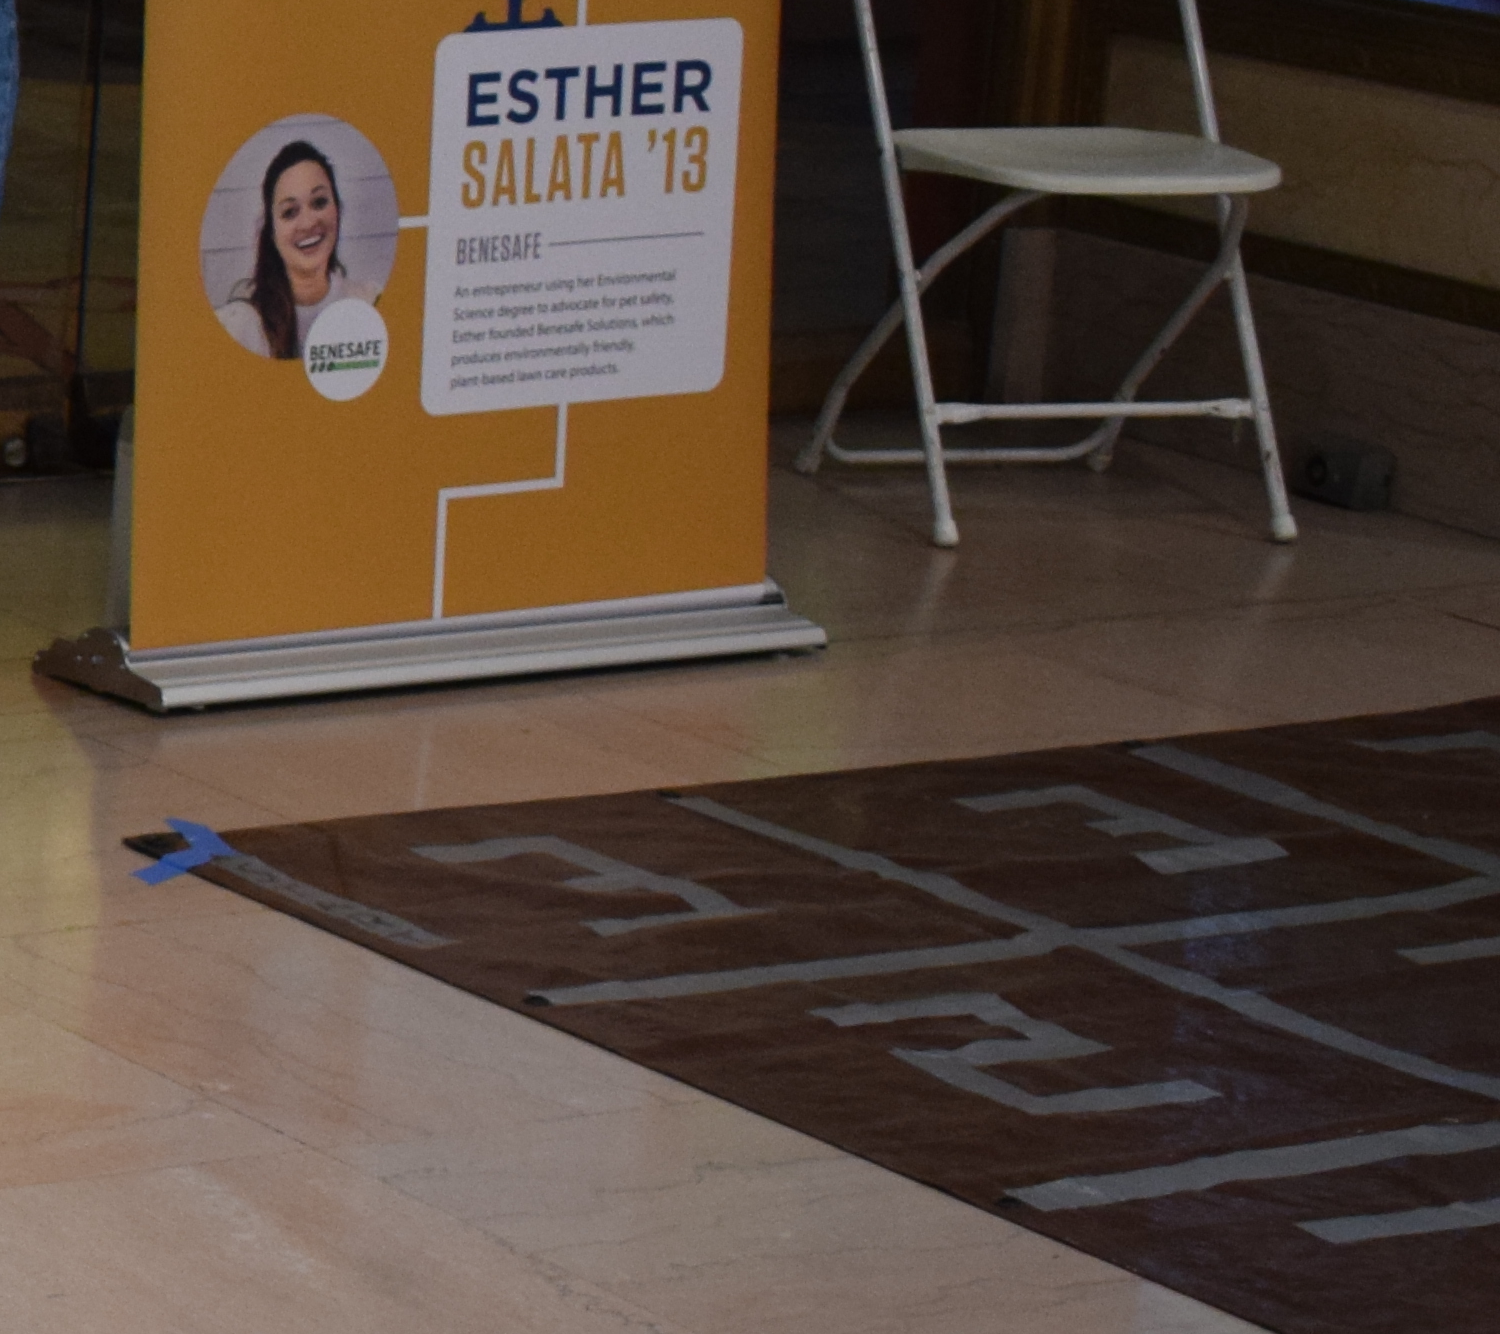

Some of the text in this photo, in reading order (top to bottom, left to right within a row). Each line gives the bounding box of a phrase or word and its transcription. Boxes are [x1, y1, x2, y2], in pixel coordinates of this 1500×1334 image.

[467, 59, 712, 126] ESTHER
[461, 126, 709, 209] SALATA '13
[456, 233, 542, 266] BENESAFE
[310, 338, 382, 363] BENESAFE
